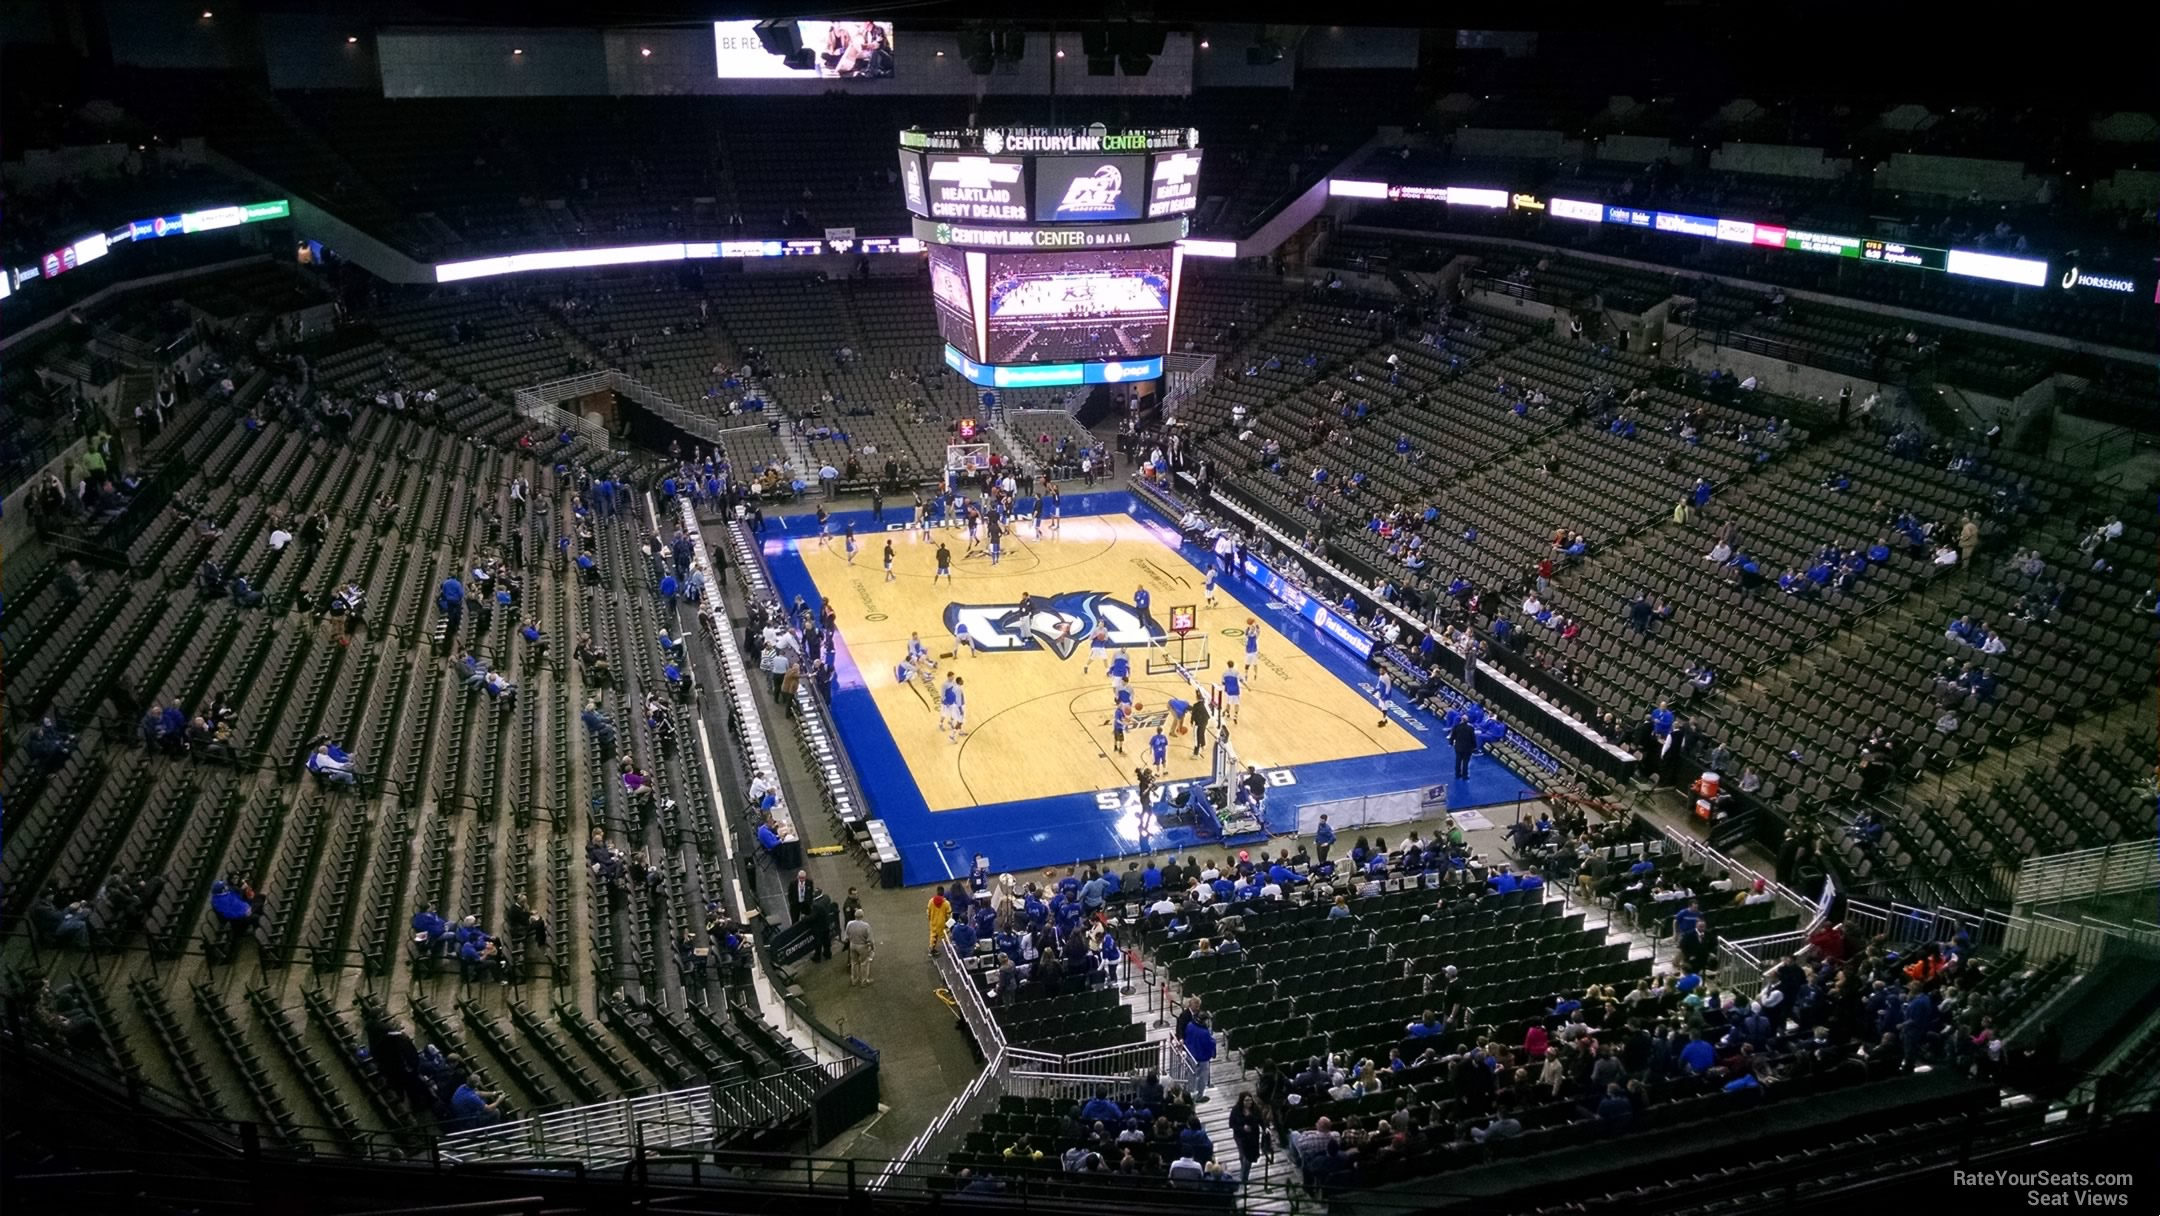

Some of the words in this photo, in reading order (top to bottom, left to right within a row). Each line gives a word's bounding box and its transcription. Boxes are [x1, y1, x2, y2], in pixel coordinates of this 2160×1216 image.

[722, 37, 737, 50] BE
[1006, 135, 1101, 151] CENTURYLINK
[1102, 135, 1146, 151] CENTER
[941, 187, 1011, 203] HEARTLAND
[1156, 183, 1192, 199] HEARTLAND
[932, 202, 971, 217] CHEVY
[972, 204, 1027, 220] DEALERS
[1149, 201, 1171, 217] CHEVY
[1169, 197, 1197, 213] DEALERS
[951, 228, 1034, 245] CENTURYLINK
[1036, 231, 1085, 246] CENTER
[1086, 233, 1131, 245] OMAHA
[2078, 275, 2135, 292] HORSESHOE
[1123, 364, 1150, 377] pepsi
[1996, 405, 2010, 417] 122
[962, 426, 974, 436] 35
[1175, 614, 1191, 628] 35
